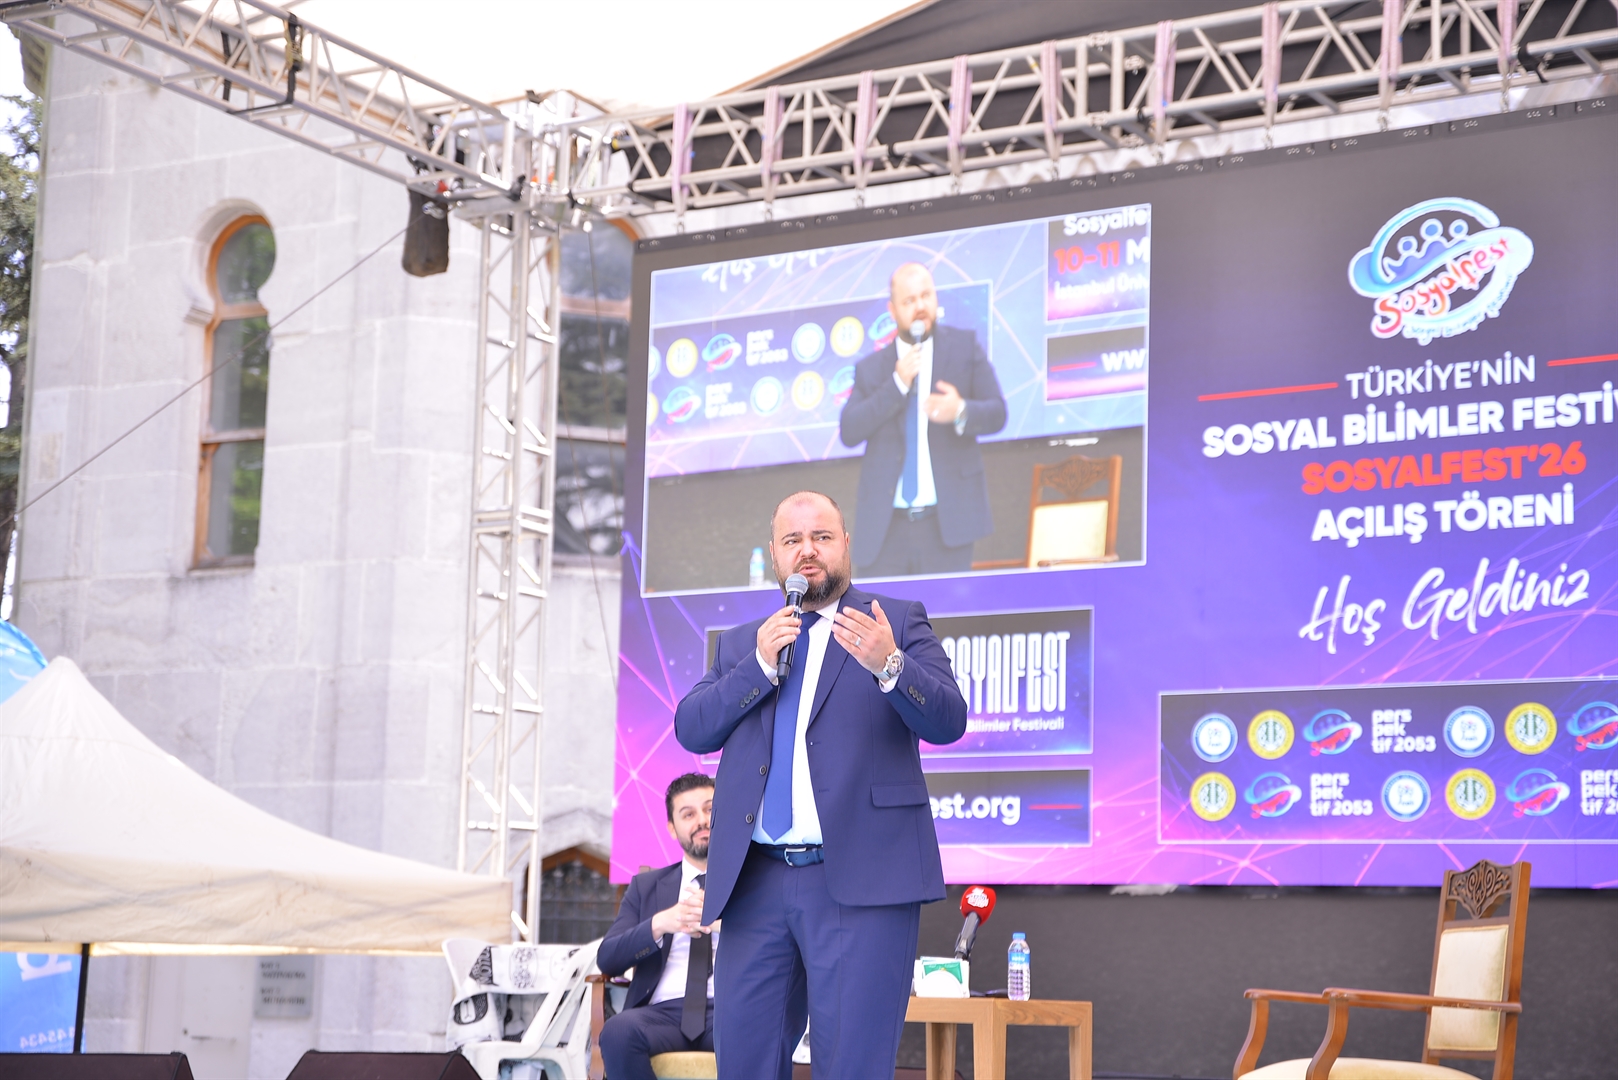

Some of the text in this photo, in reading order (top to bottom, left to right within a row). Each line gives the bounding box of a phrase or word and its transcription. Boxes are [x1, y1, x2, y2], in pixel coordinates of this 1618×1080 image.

[1063, 207, 1150, 236] Sosyalfe
[1375, 237, 1512, 334] Sosyalfest
[1345, 351, 1536, 399] TÜRKİYE'NİN
[1202, 416, 1338, 458] SOSYAL
[1343, 400, 1505, 446] BİLİMLER
[1302, 441, 1587, 495] SOSYALFEST'26
[1311, 482, 1574, 548] AÇILIŞ TÖRENİ
[1298, 557, 1590, 655] Hoş Geldiniz
[966, 714, 1065, 733] Bilimler Festivali
[1372, 708, 1412, 724] pers
[1372, 722, 1407, 738] pek
[1393, 735, 1437, 753] 2053
[1310, 772, 1350, 786] pers
[1310, 786, 1344, 800] pek
[1331, 799, 1373, 816] 2053
[1604, 798, 1618, 815] 2
